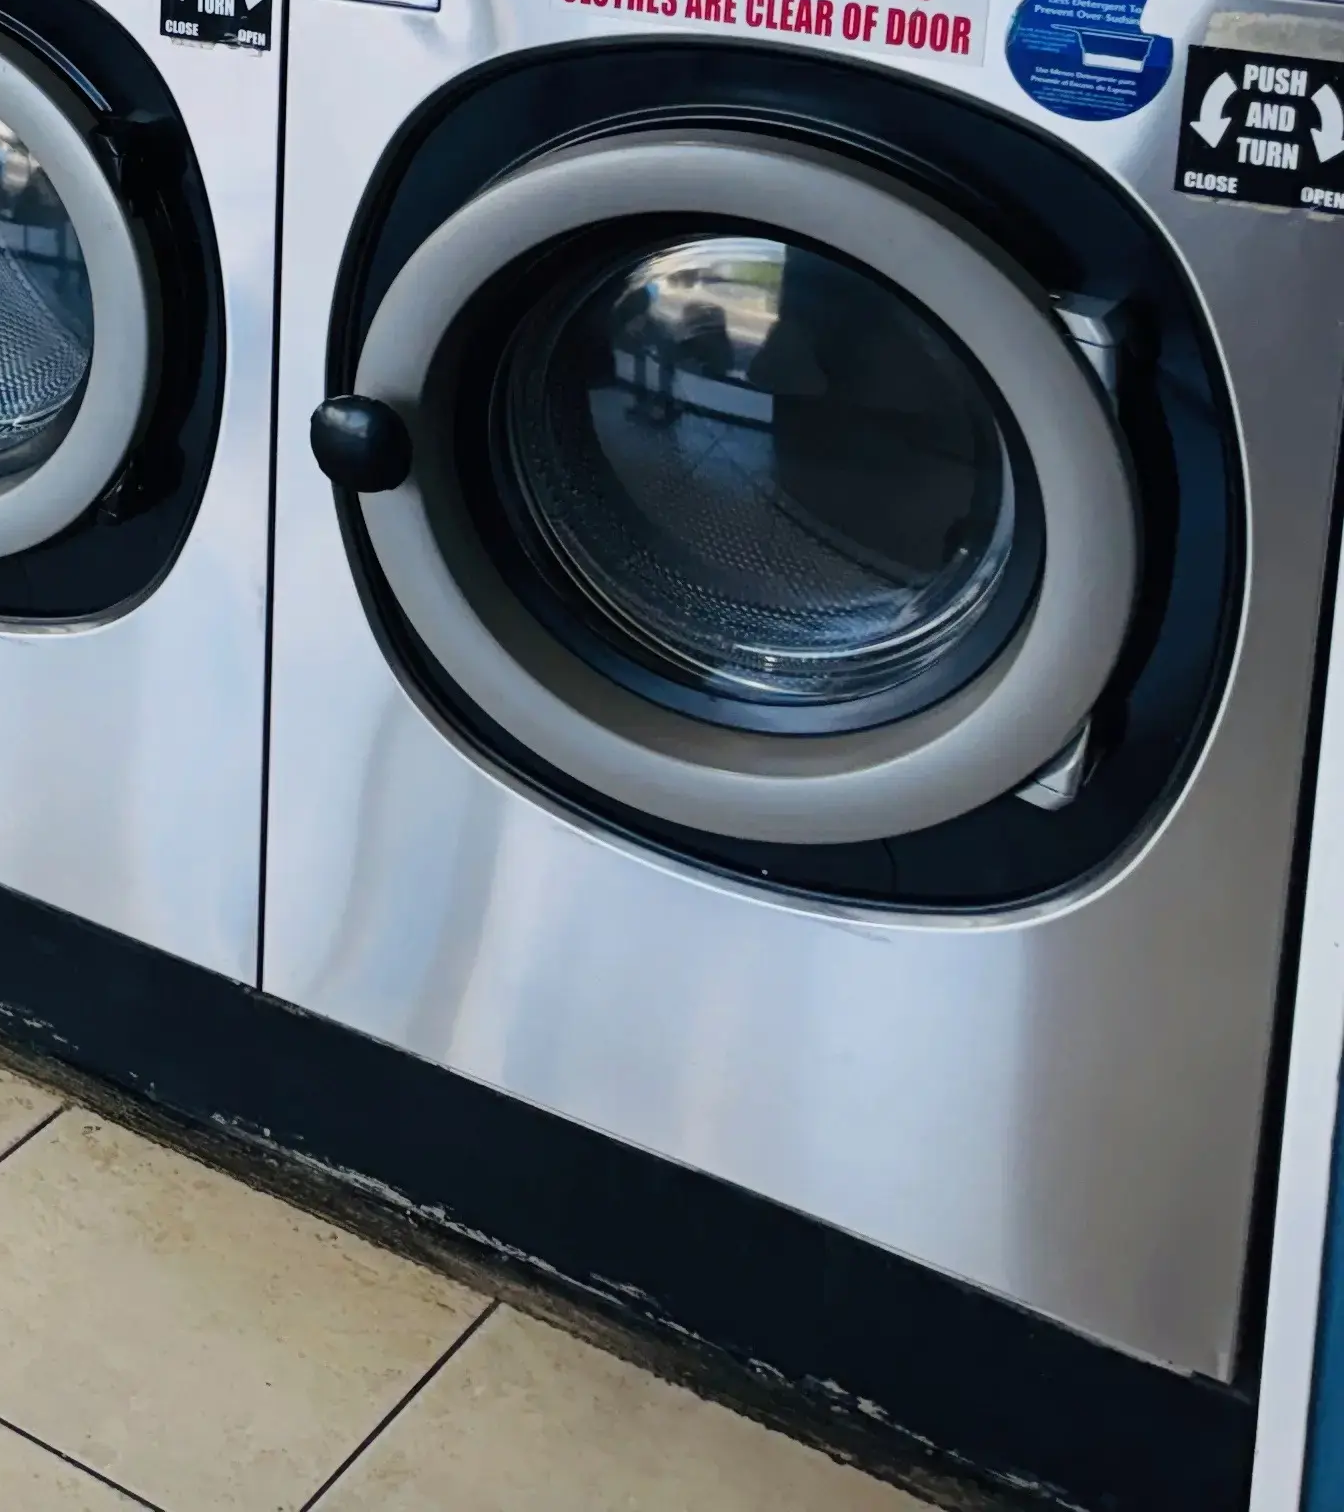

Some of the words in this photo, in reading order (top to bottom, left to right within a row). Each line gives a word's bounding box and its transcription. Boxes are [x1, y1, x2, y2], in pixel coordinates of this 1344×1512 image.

[1034, 5, 1074, 17] Prevent
[1077, 10, 1101, 20] Over
[1130, 5, 1142, 14] To
[165, 19, 199, 36] CLOSE
[238, 29, 265, 46] OPEN
[842, 2, 878, 45] OF
[886, 7, 971, 55] DOOR
[1243, 64, 1308, 97] PUSH
[1245, 101, 1296, 132] AND
[1237, 136, 1300, 170] TURN
[1184, 170, 1239, 194] CLOSE
[1300, 187, 1344, 209] OPEN
